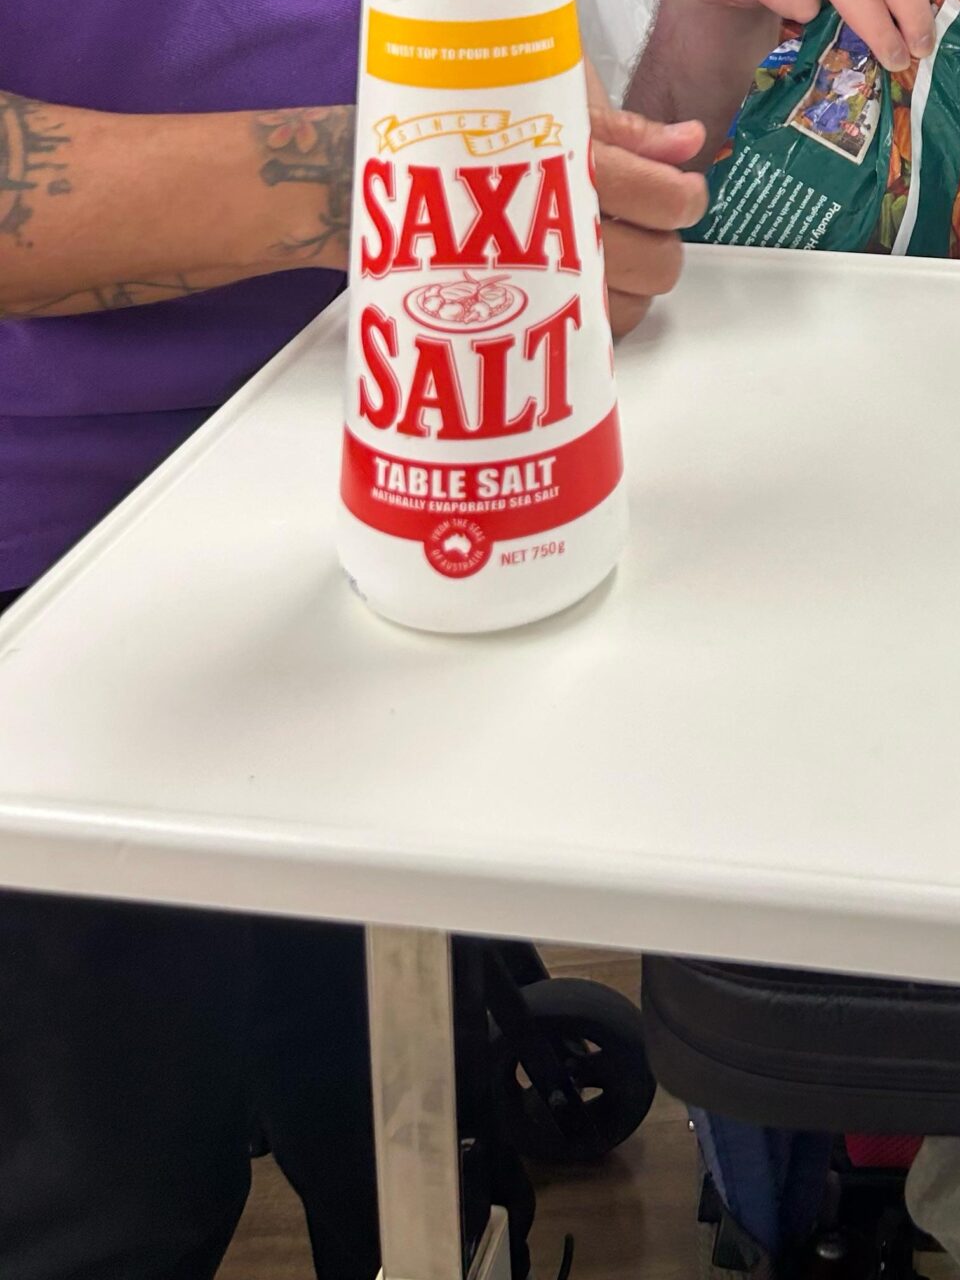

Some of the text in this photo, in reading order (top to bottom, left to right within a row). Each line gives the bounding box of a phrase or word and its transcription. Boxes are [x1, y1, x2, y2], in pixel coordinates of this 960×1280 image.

[441, 48, 456, 61] TO
[459, 47, 491, 61] POUR
[398, 114, 489, 143] SINCE
[755, 167, 782, 204] vegetables
[781, 174, 793, 188] like
[788, 181, 804, 201] round
[735, 197, 747, 212] and
[779, 200, 793, 217] with
[797, 187, 814, 209] grown
[804, 193, 827, 223] Bringing
[361, 154, 582, 280] SAXA
[758, 208, 772, 225] Tom
[772, 215, 783, 228] the
[777, 208, 802, 242] vegetables
[797, 220, 810, 235] you
[810, 200, 841, 239] Proudly
[750, 223, 762, 237] and
[762, 226, 776, 241] help
[360, 294, 582, 441] SALT
[375, 456, 556, 499] TABLE SALT
[371, 486, 560, 513] NATURALLY EVAPORATED SEA SALT
[452, 518, 468, 527] THE
[441, 550, 485, 572] AUSTRALIA
[501, 540, 565, 566] NET 750g
